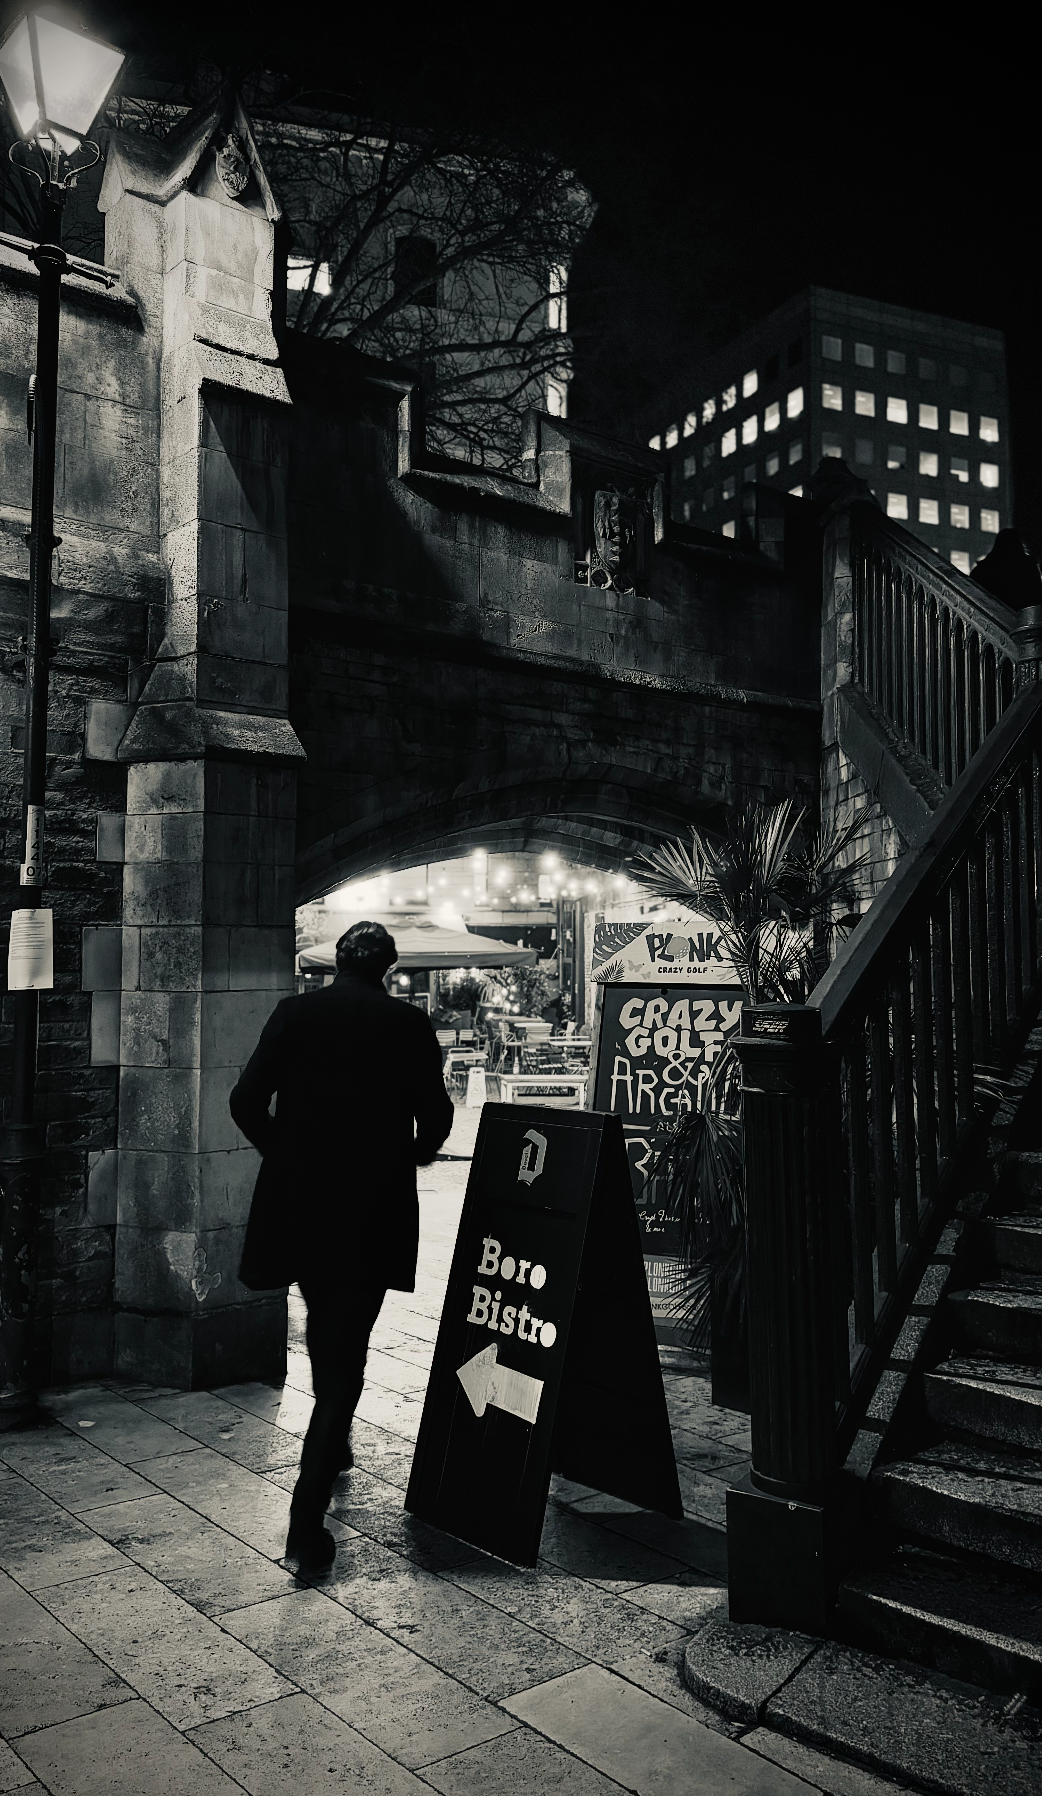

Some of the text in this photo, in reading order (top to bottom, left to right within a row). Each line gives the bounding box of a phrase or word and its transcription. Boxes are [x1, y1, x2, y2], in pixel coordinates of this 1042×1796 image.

[645, 932, 725, 962] PLONK
[619, 997, 743, 1032] CRAZY
[625, 1026, 724, 1062] GOLF
[661, 1050, 710, 1085] &
[478, 1236, 547, 1290] Boro
[467, 1285, 557, 1347] Bistro
